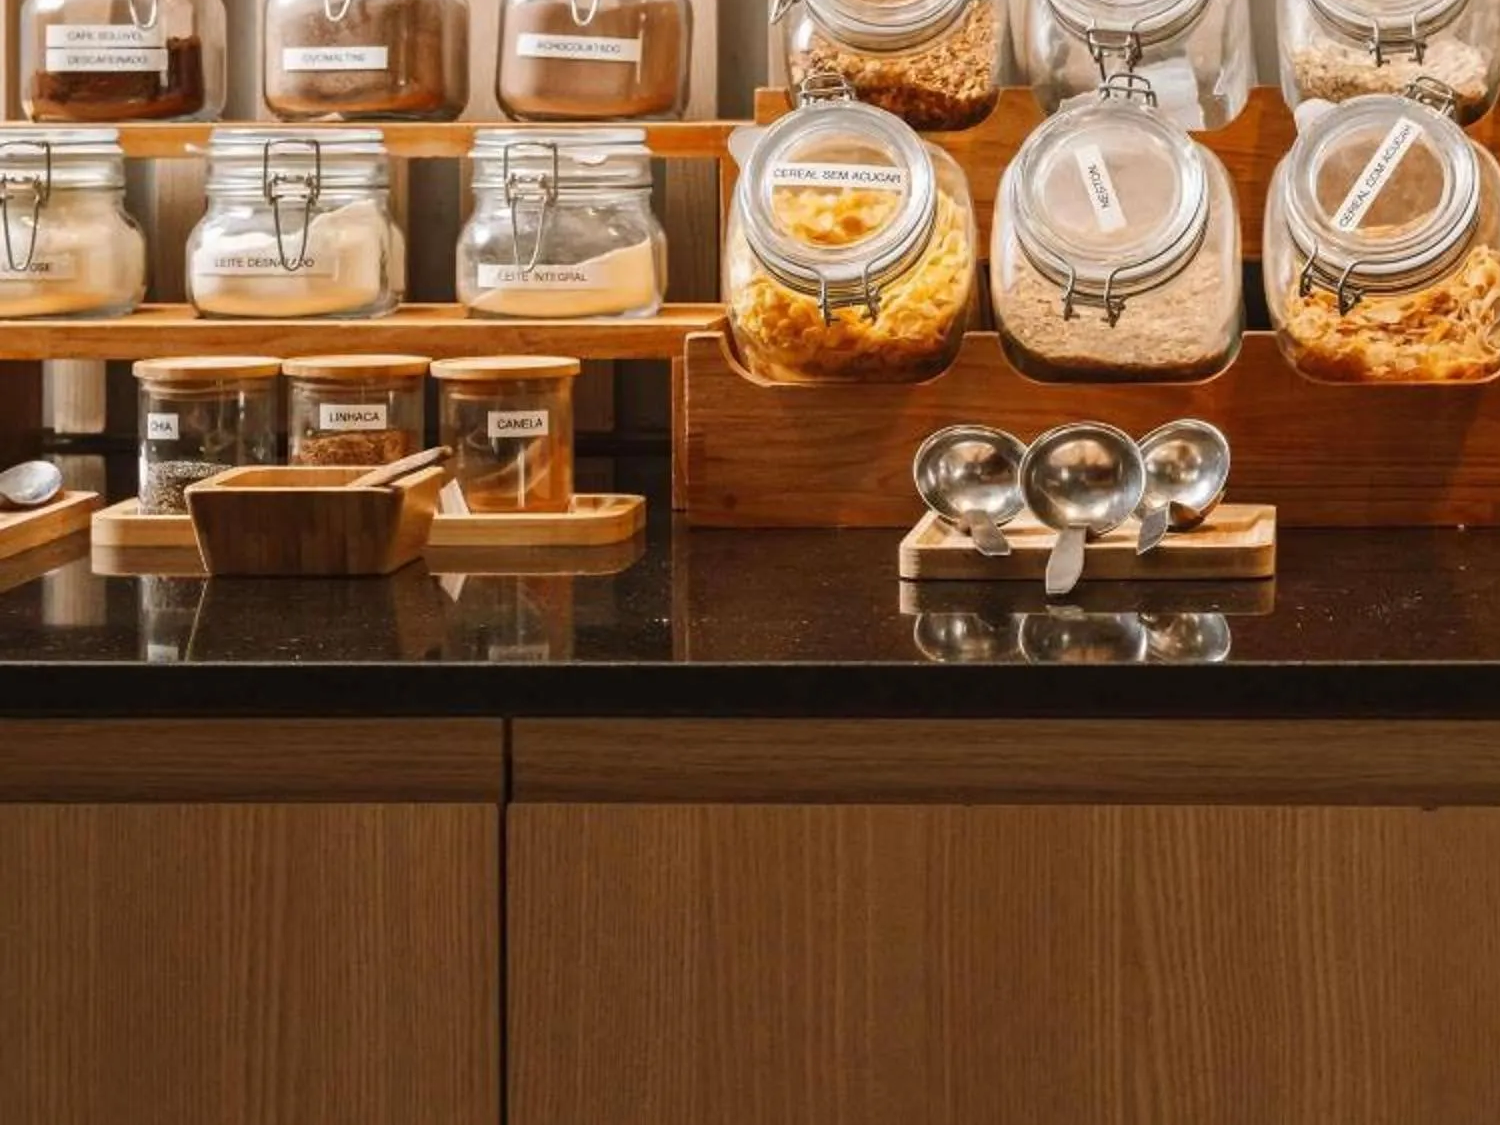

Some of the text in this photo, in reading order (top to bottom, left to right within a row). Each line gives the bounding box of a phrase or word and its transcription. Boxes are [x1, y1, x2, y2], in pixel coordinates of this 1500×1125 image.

[773, 167, 818, 180] CEREAL
[821, 169, 849, 181] SEM
[1339, 190, 1371, 228] CEREAL
[1365, 162, 1386, 188] COM
[214, 257, 246, 269] LEITE
[498, 270, 588, 283] LEITE INTEGRAL
[496, 417, 544, 431] CANELA
